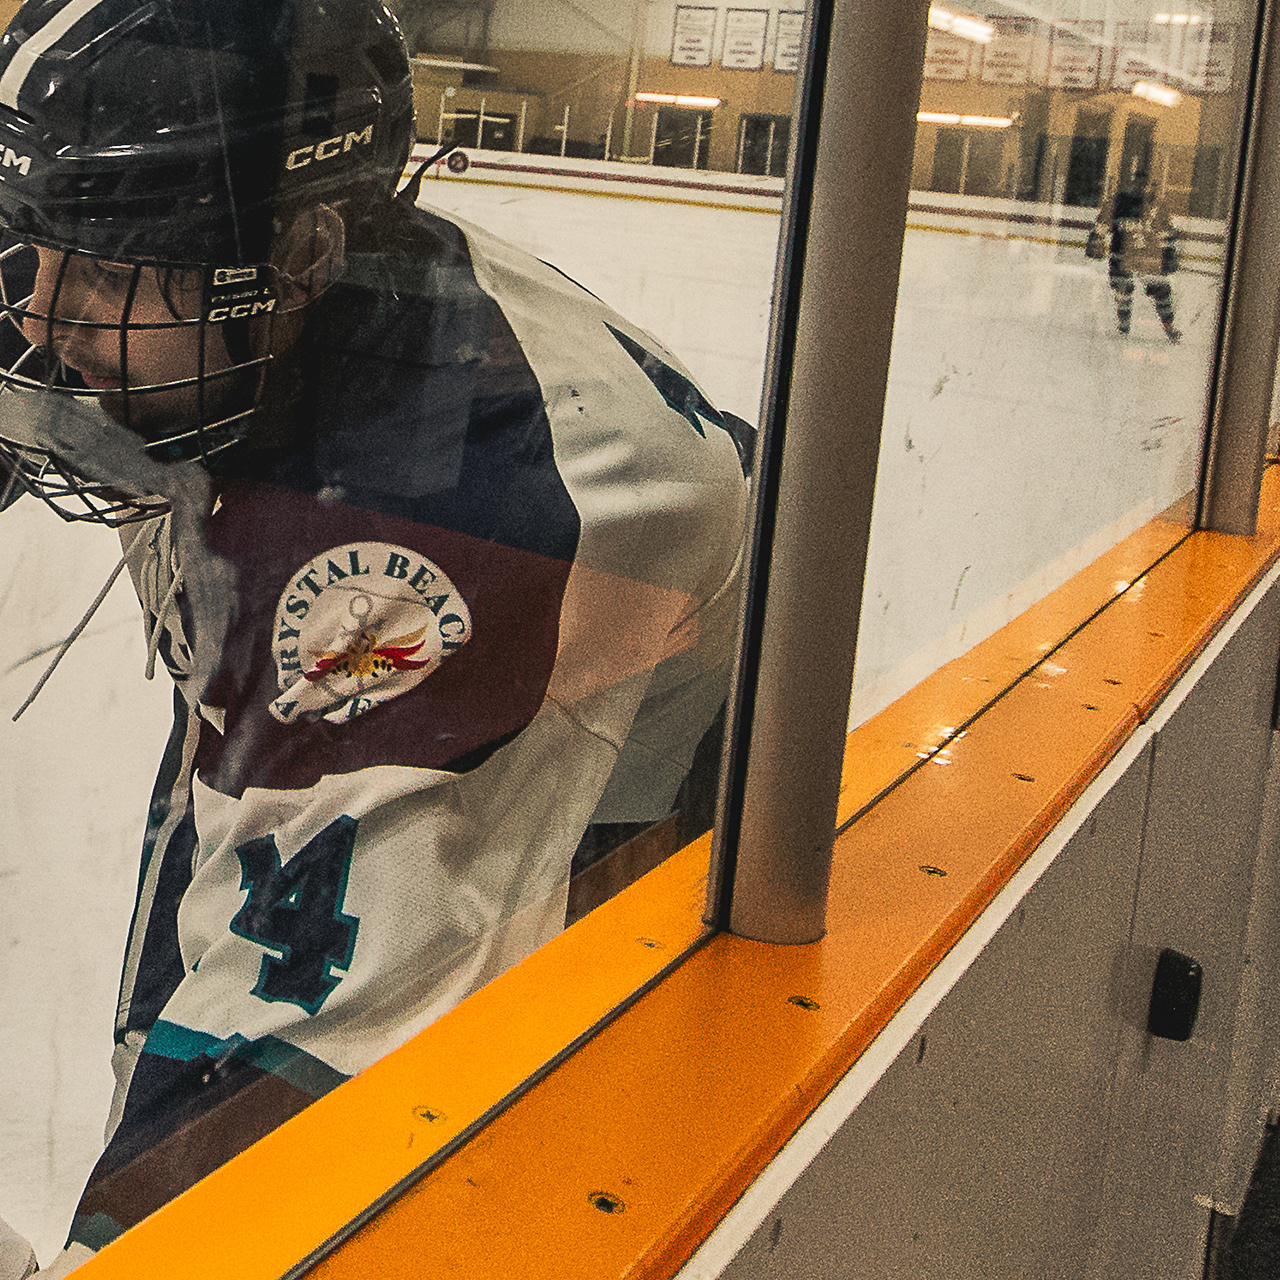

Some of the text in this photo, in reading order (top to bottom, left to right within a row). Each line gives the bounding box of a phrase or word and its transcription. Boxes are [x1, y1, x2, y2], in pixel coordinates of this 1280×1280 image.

[284, 124, 375, 171] CCM
[207, 297, 277, 323] CCM
[228, 813, 361, 1017] 4
